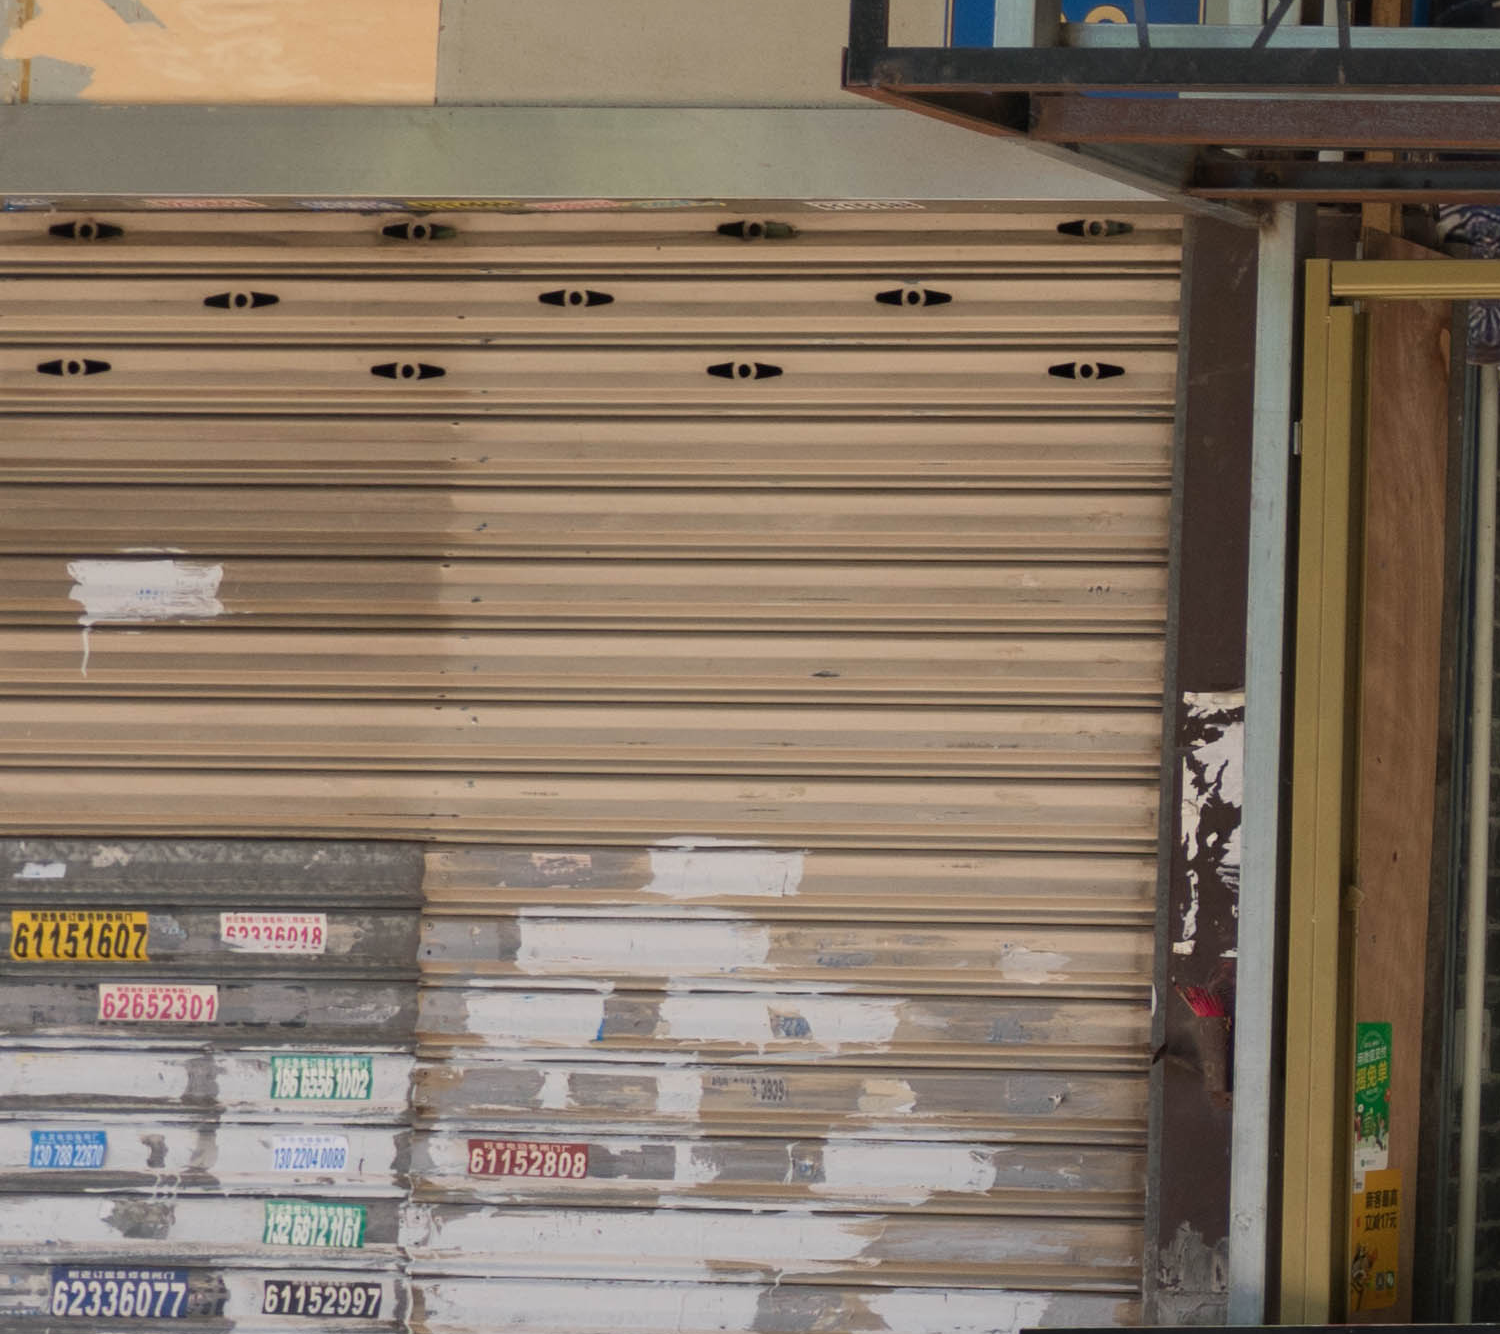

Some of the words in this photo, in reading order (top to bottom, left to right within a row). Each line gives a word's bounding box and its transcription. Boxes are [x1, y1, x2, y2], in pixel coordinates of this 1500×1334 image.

[14, 923, 148, 959] 61151607
[103, 994, 217, 1021] 62652301
[274, 1147, 292, 1170] 130
[292, 1147, 319, 1169] 2204
[469, 1147, 587, 1177] 61152808
[52, 1281, 187, 1317] 62336077
[264, 1286, 381, 1317] 61152997
